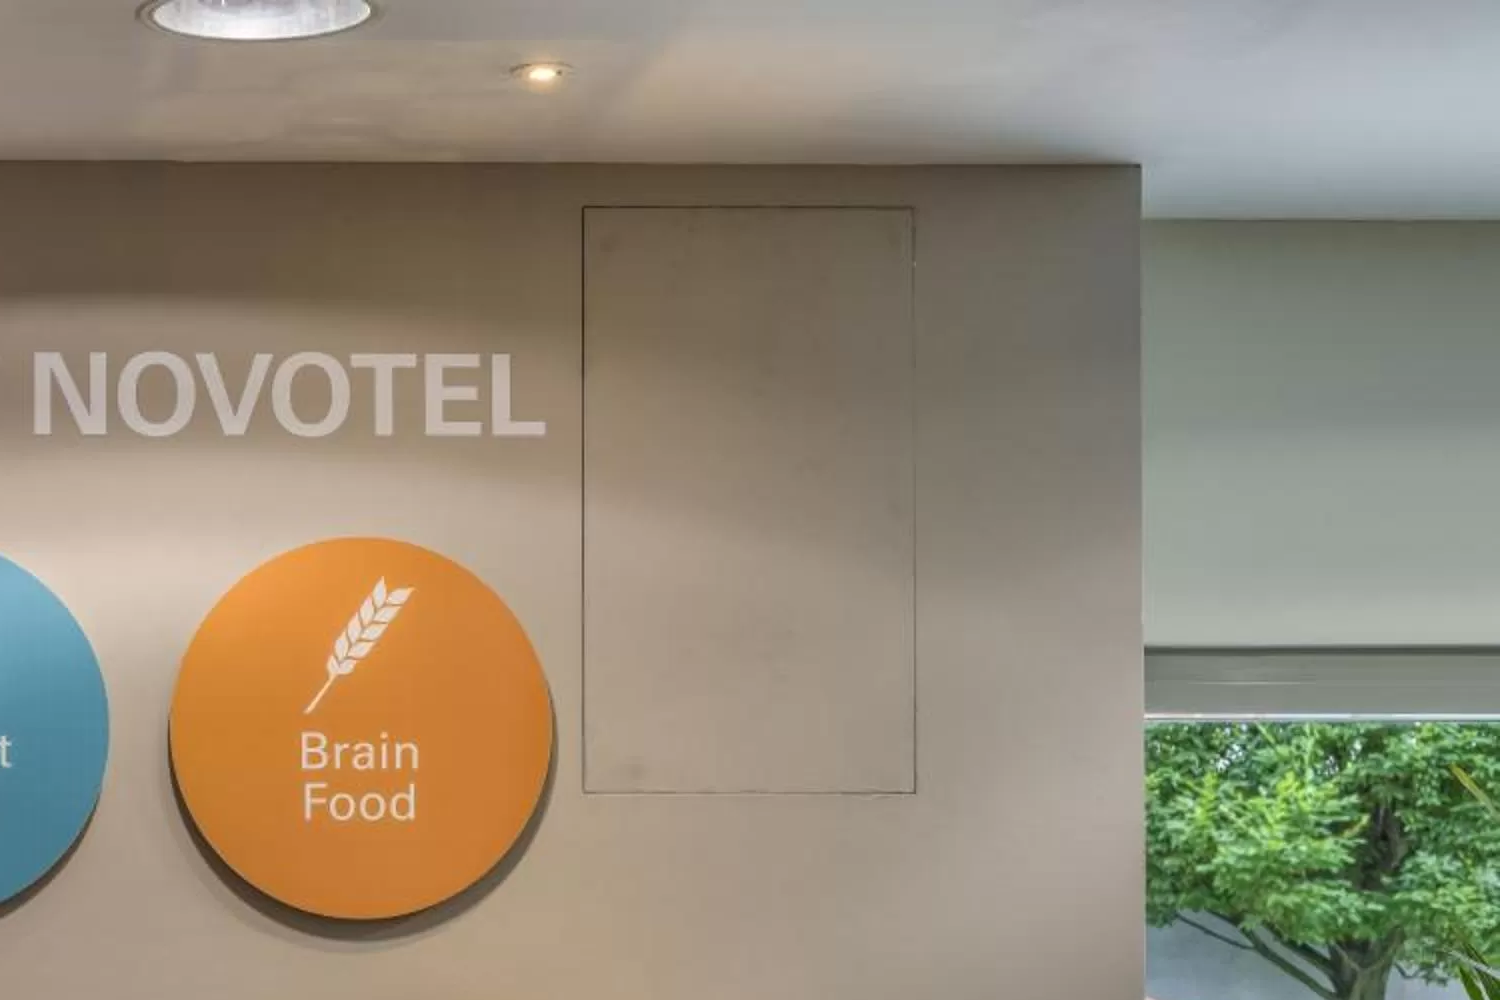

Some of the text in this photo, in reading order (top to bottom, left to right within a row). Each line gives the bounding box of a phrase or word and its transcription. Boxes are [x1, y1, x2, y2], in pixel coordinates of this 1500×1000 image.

[32, 350, 547, 438] NOVOTEL
[301, 733, 418, 769] Brain
[304, 782, 416, 820] Food
